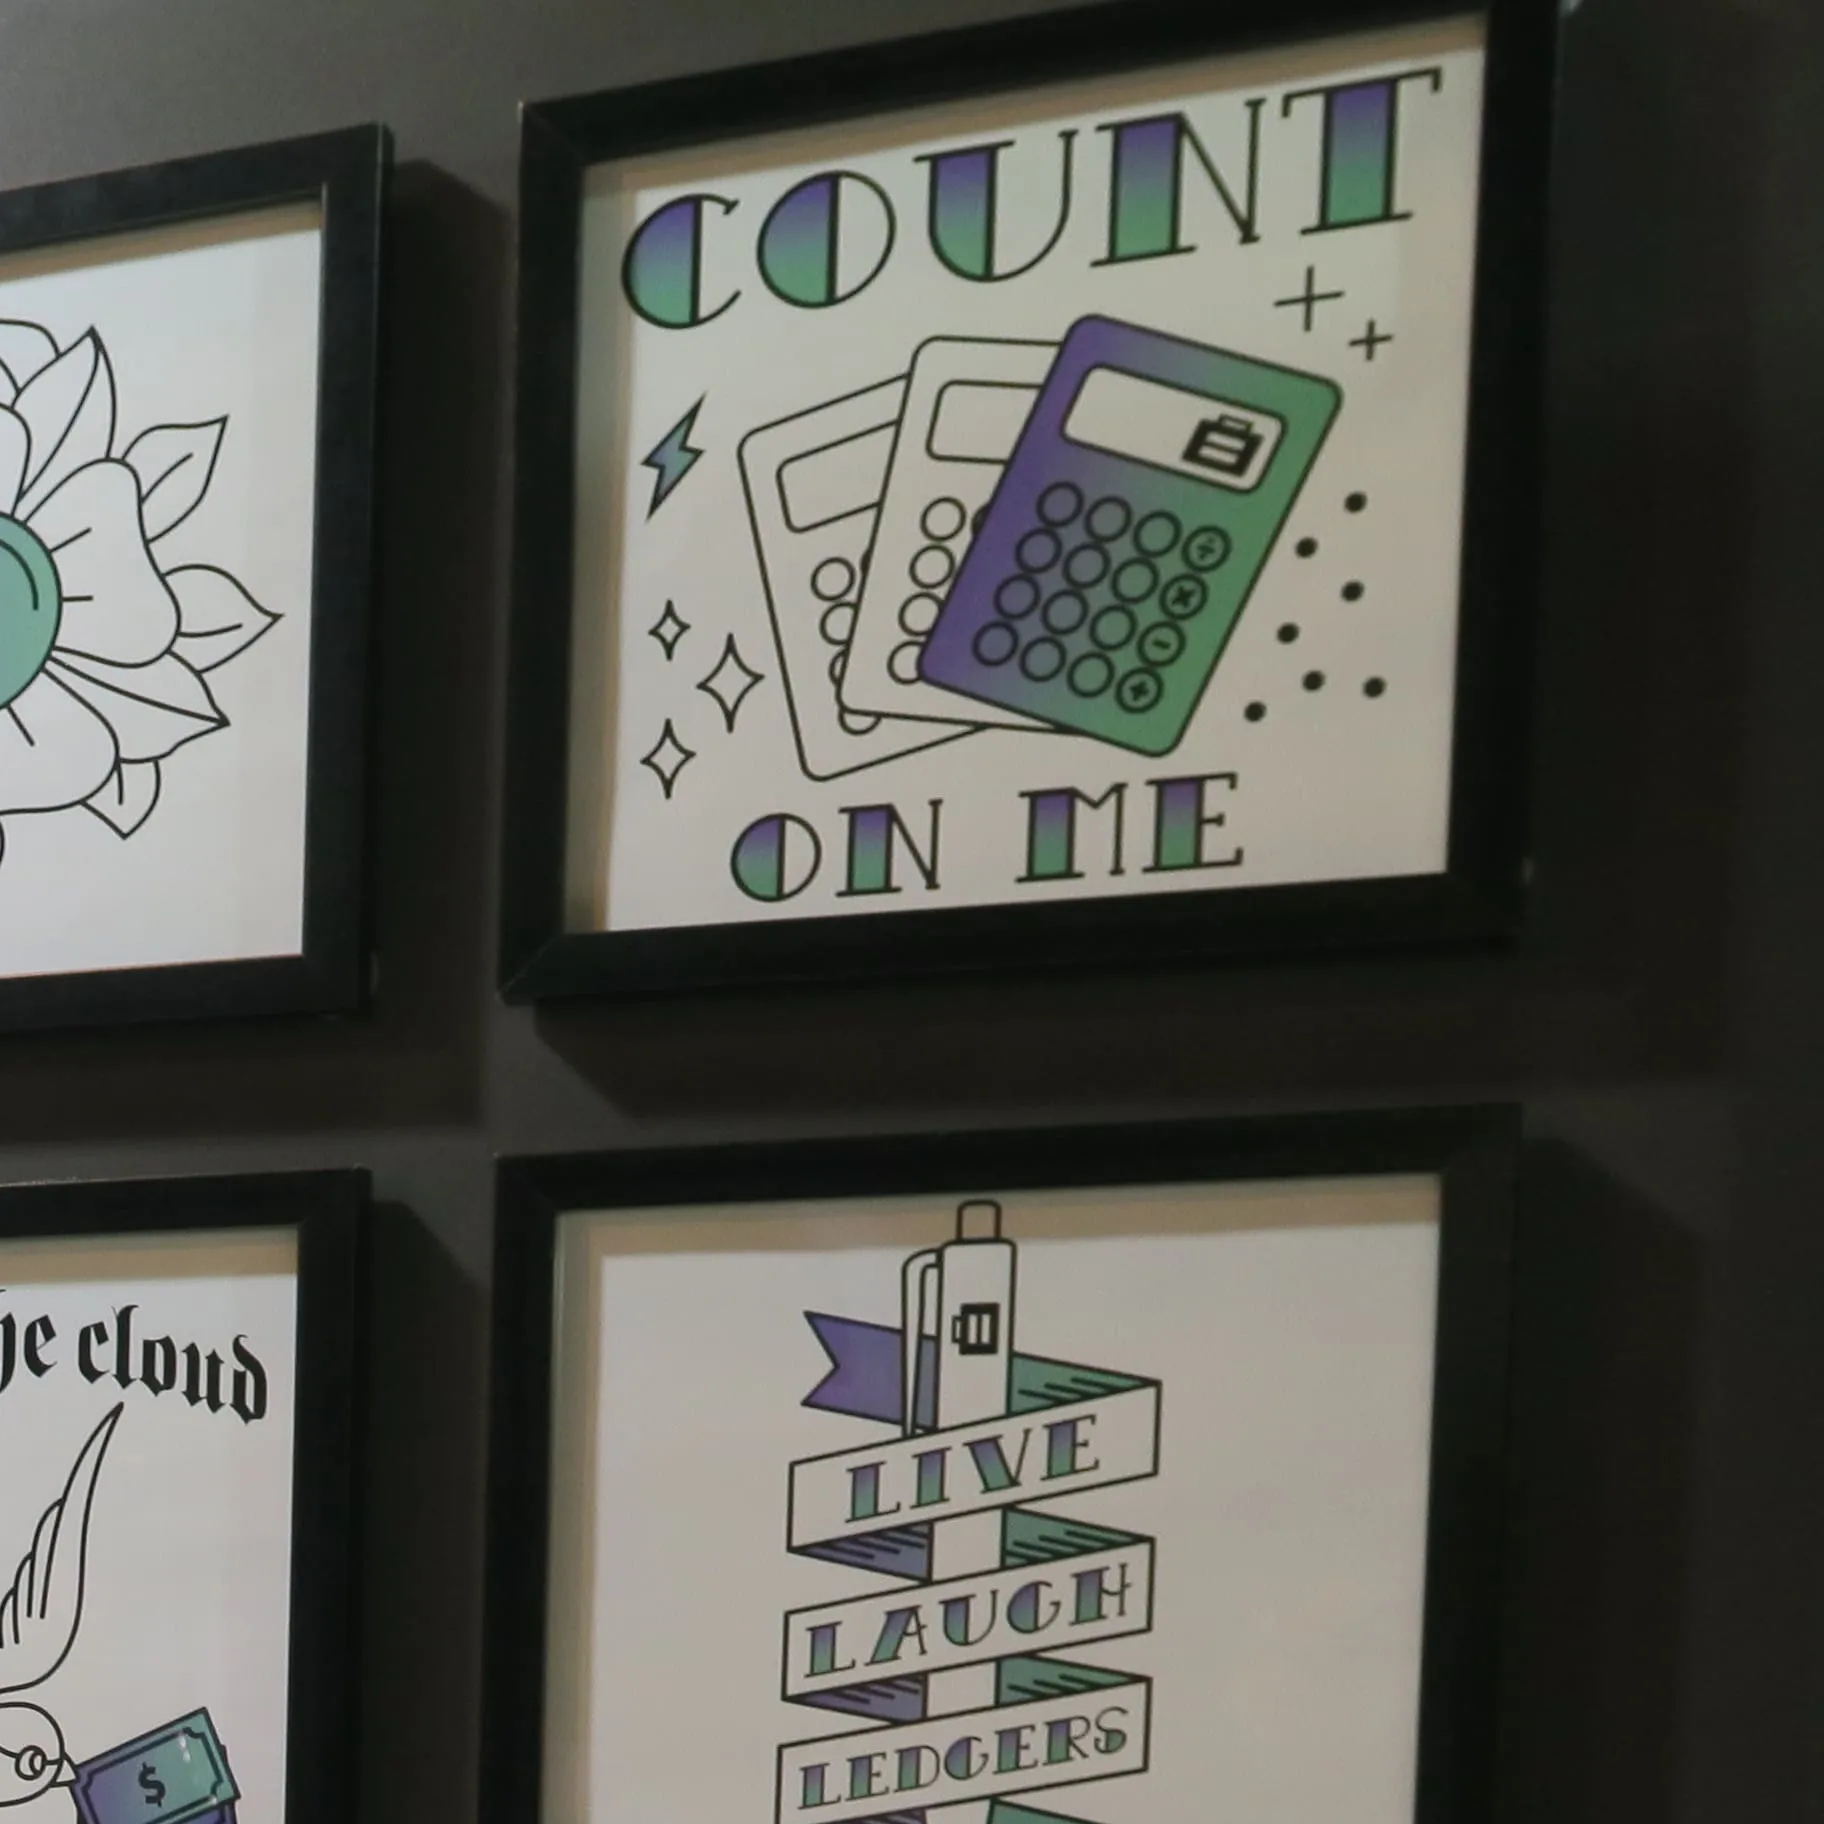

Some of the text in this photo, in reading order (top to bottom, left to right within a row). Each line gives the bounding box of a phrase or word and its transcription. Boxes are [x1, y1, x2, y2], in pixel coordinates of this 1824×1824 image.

[620, 67, 1444, 330] COUNT
[730, 771, 1244, 903] ON ME
[77, 1303, 268, 1425] cloud
[844, 1413, 1101, 1523] LIVE
[803, 1562, 1133, 1679] LAUGH
[798, 1706, 1130, 1811] LEDGERS
